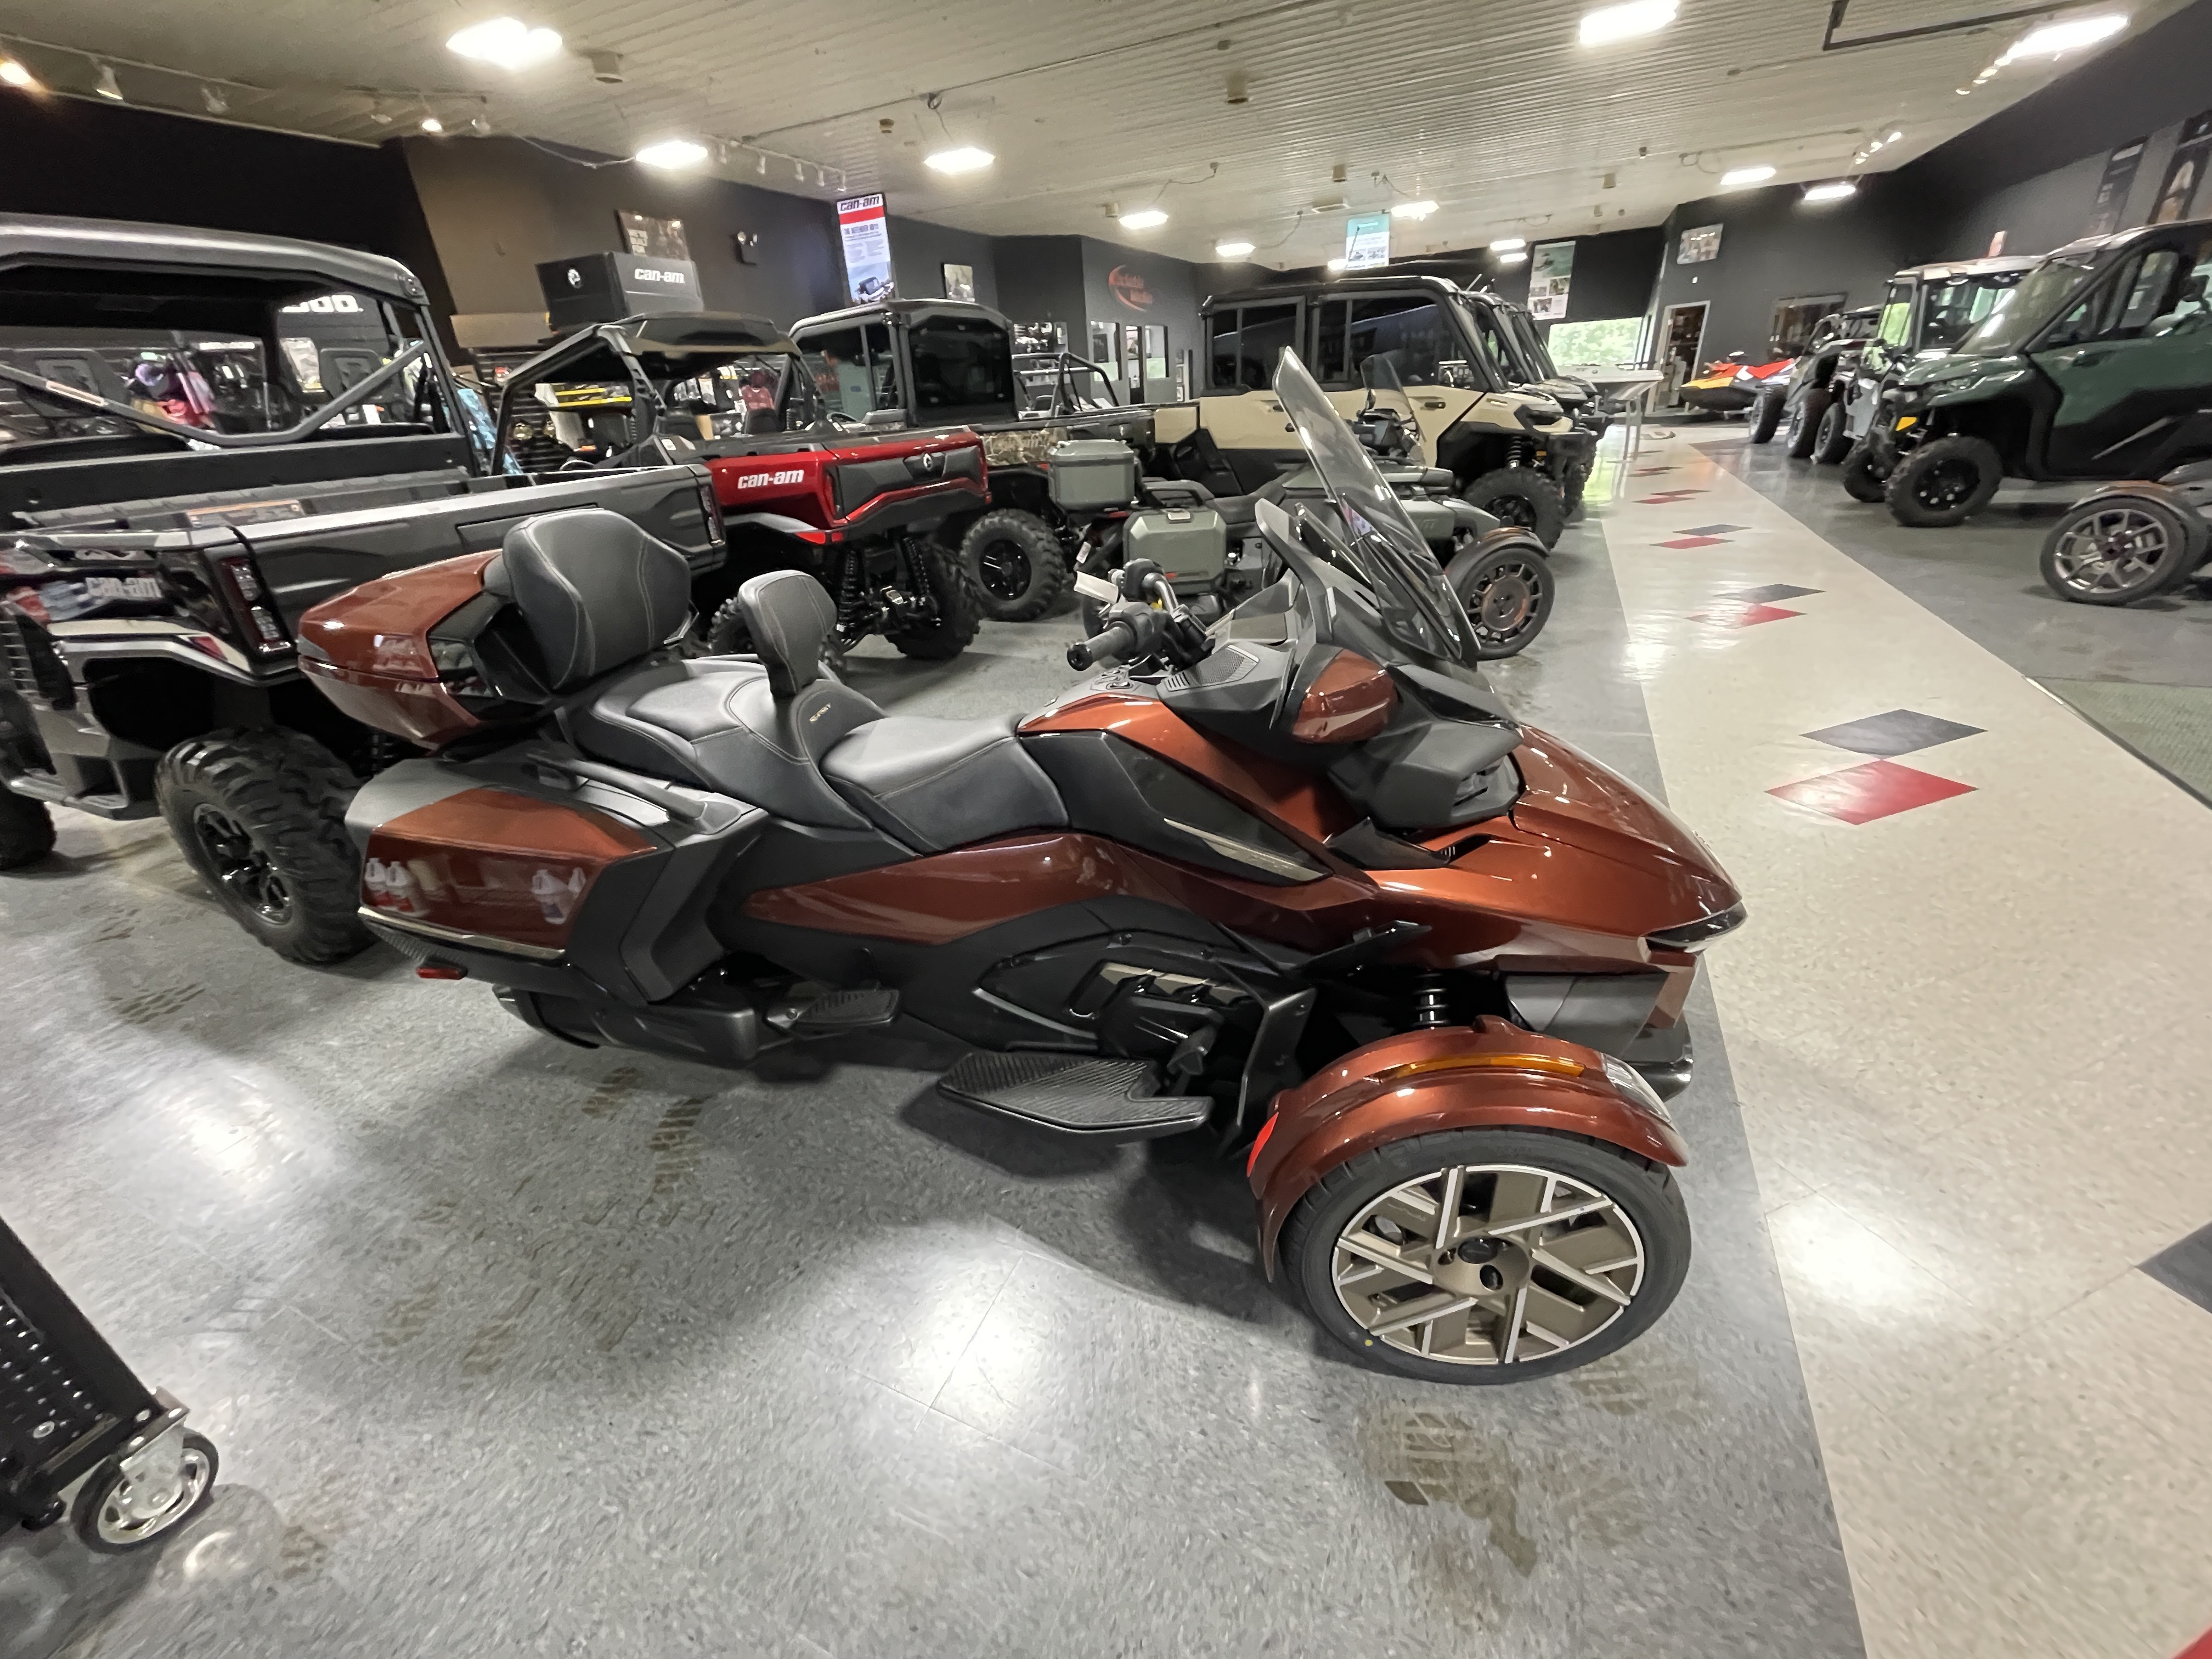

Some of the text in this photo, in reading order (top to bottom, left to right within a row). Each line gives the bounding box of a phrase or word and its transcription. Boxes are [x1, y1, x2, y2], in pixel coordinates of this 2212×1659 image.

[840, 196, 880, 212] can-am
[634, 268, 685, 284] can-am
[737, 469, 805, 489] can-am
[85, 577, 162, 599] can-am
